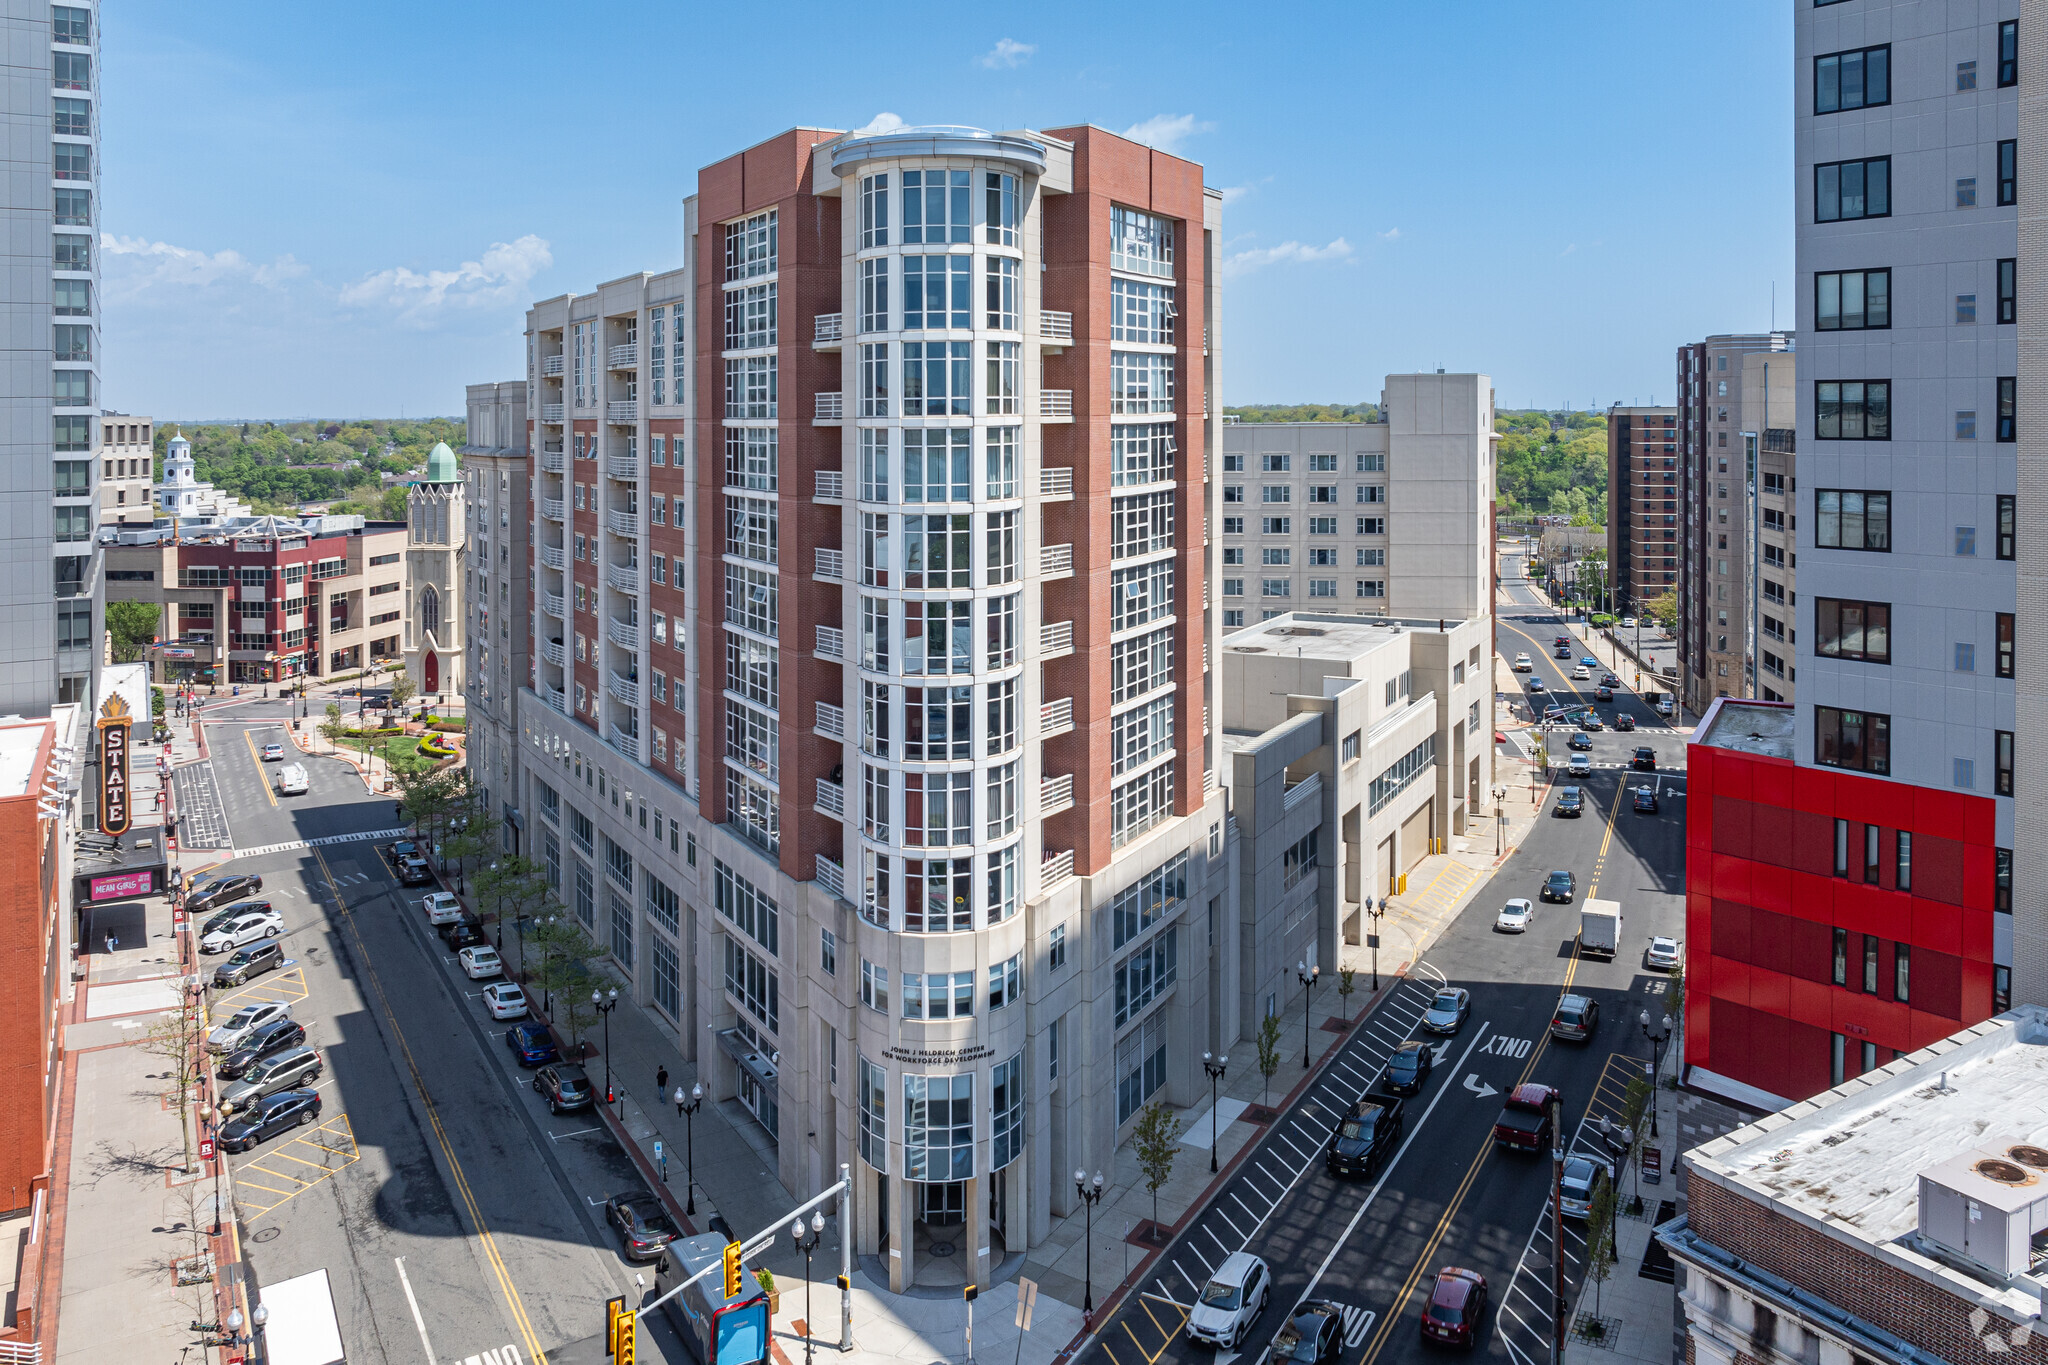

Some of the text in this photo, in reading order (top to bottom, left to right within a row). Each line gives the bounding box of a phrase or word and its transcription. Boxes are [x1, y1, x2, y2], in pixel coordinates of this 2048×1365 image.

[107, 730, 124, 822] STATE
[95, 884, 115, 894] MEAN
[116, 880, 137, 890] GIRLS
[175, 911, 182, 919] R
[890, 1046, 909, 1054] JOHN
[958, 1045, 985, 1055] CENTER
[1478, 1035, 1532, 1058] ONLY
[881, 1050, 995, 1064] FOR WORKFORCE DEVELOPMENT
[201, 1143, 212, 1153] R
